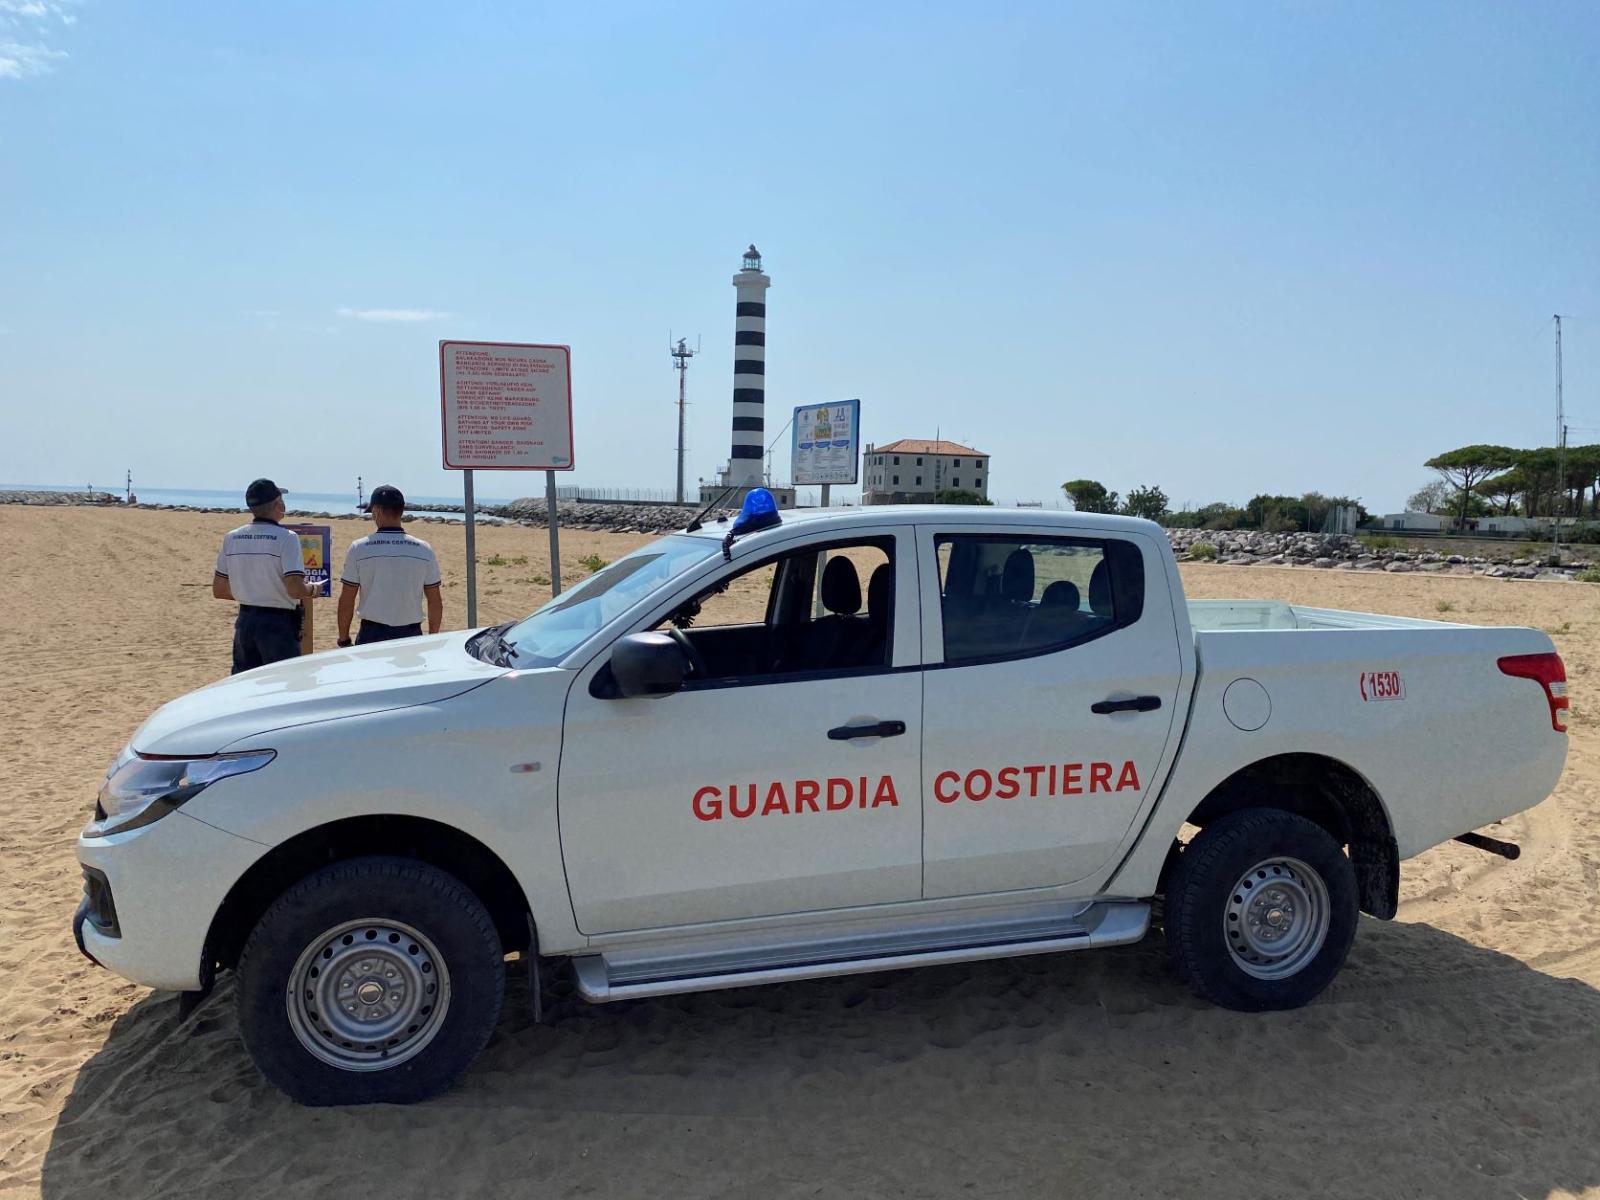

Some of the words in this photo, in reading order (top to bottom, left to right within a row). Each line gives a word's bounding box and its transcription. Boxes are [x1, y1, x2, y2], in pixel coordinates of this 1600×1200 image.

[1369, 671, 1399, 697] 1530
[692, 775, 899, 822] GUARDIA
[933, 760, 1141, 804] COSTIERA
